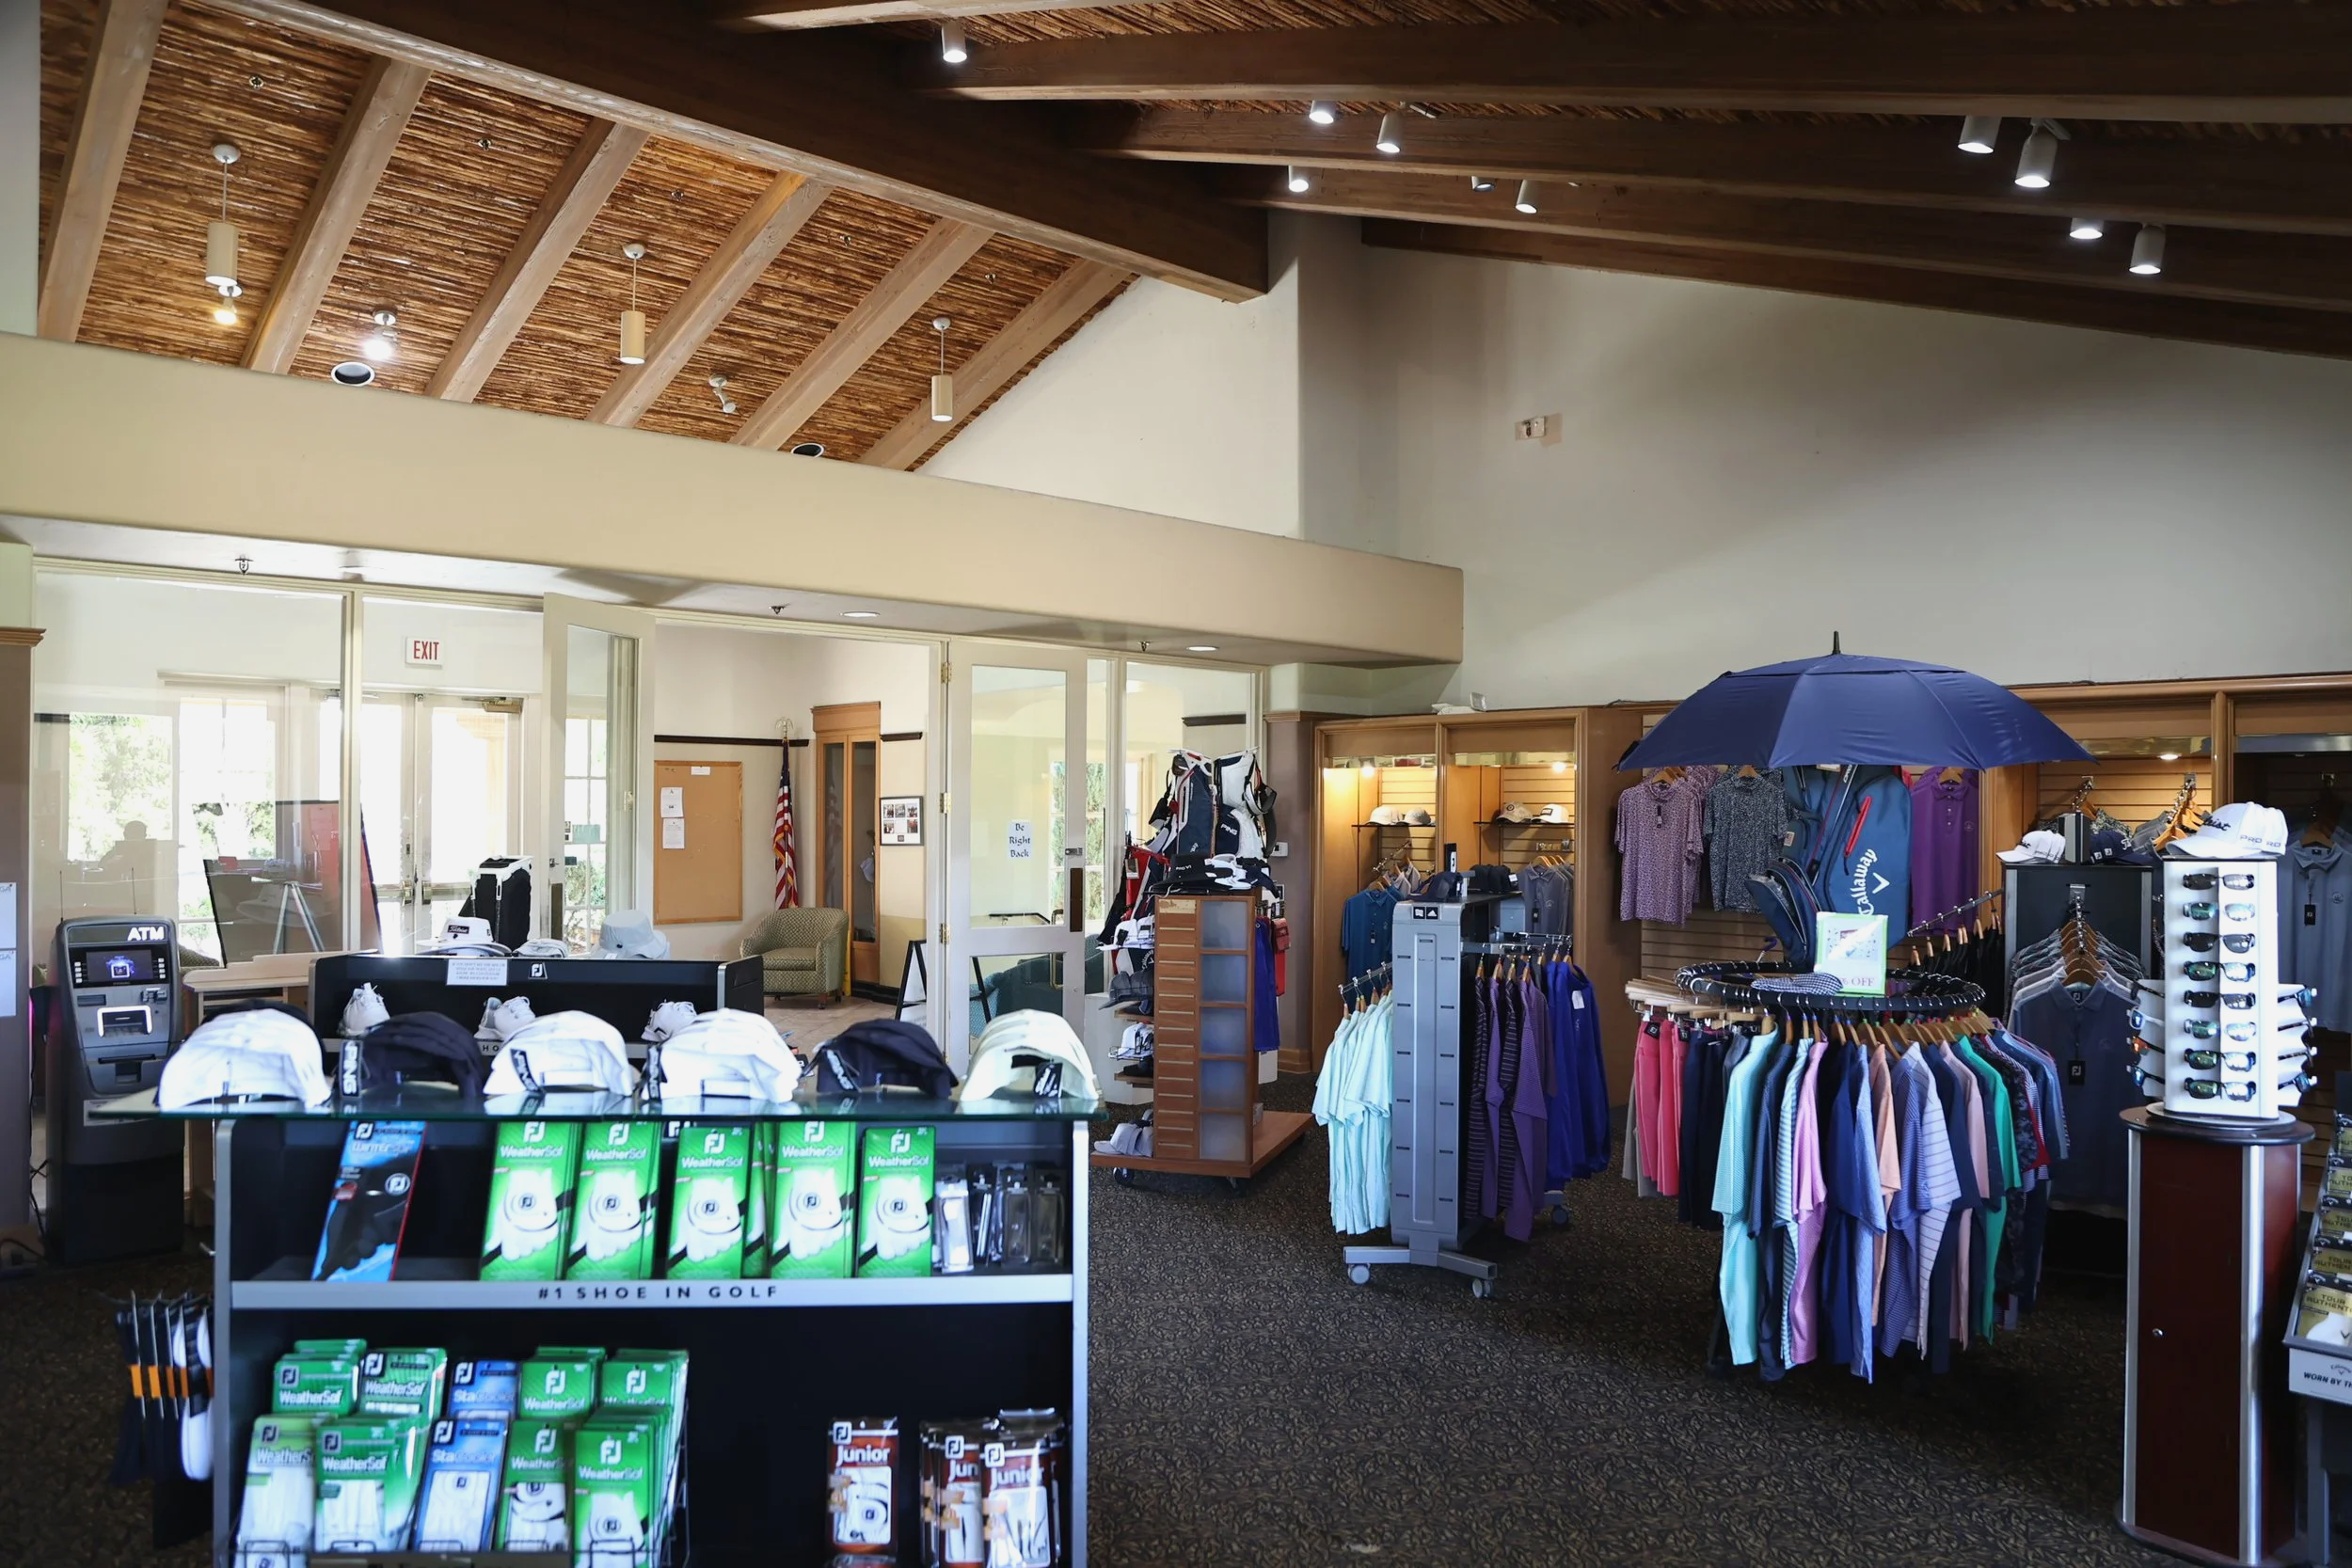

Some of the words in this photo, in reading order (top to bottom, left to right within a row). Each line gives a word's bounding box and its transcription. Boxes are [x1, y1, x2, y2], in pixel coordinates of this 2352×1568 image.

[414, 641, 439, 660] EXIT
[1220, 823, 1238, 835] PING
[1009, 836, 1030, 847] Right
[2240, 835, 2263, 844] PRO
[1850, 848, 1878, 916] Callaway
[127, 926, 165, 942] ATM
[532, 963, 543, 977] FJ
[1851, 977, 1875, 987] OFF
[343, 1040, 358, 1095] PING
[2072, 1065, 2081, 1077] FJ
[356, 1123, 374, 1139] FJ
[523, 1121, 546, 1143] FJ
[608, 1123, 629, 1146] FJ
[804, 1121, 825, 1143] FJ
[704, 1133, 725, 1154] FJ
[890, 1132, 912, 1153] FJ
[501, 1145, 564, 1158] WeatherSof
[586, 1147, 647, 1161] WeatherSof
[782, 1145, 844, 1158] WeatherSof
[681, 1156, 743, 1168] WeatherSof
[868, 1155, 930, 1167] WeatherSof
[389, 1177, 407, 1192] FJ
[538, 1287, 562, 1299] #1
[577, 1287, 646, 1299] SHOE
[665, 1287, 691, 1299] IN
[708, 1286, 777, 1299] GOLF
[2322, 1294, 2345, 1305] TOUR
[365, 1353, 384, 1376] FJ
[282, 1369, 296, 1385] FJ
[454, 1363, 473, 1384] FJ
[2304, 1371, 2328, 1383] WORN
[365, 1380, 427, 1396] WeatherSof
[546, 1370, 565, 1394] FJ
[626, 1370, 646, 1394] FJ
[279, 1389, 342, 1405] WeatherSof
[524, 1397, 585, 1410] WeatherSof
[262, 1425, 278, 1442] FJ
[434, 1421, 453, 1444] FJ
[835, 1426, 849, 1441] FJ
[325, 1434, 339, 1451] FJ
[534, 1429, 557, 1453] FJ
[948, 1440, 961, 1454] FJ
[600, 1439, 622, 1465] FJ
[835, 1445, 891, 1467] Junior
[988, 1449, 1001, 1463] FJ
[323, 1455, 387, 1471] WeatherSof
[948, 1460, 978, 1482] Jun
[579, 1466, 643, 1481] WeatherSof
